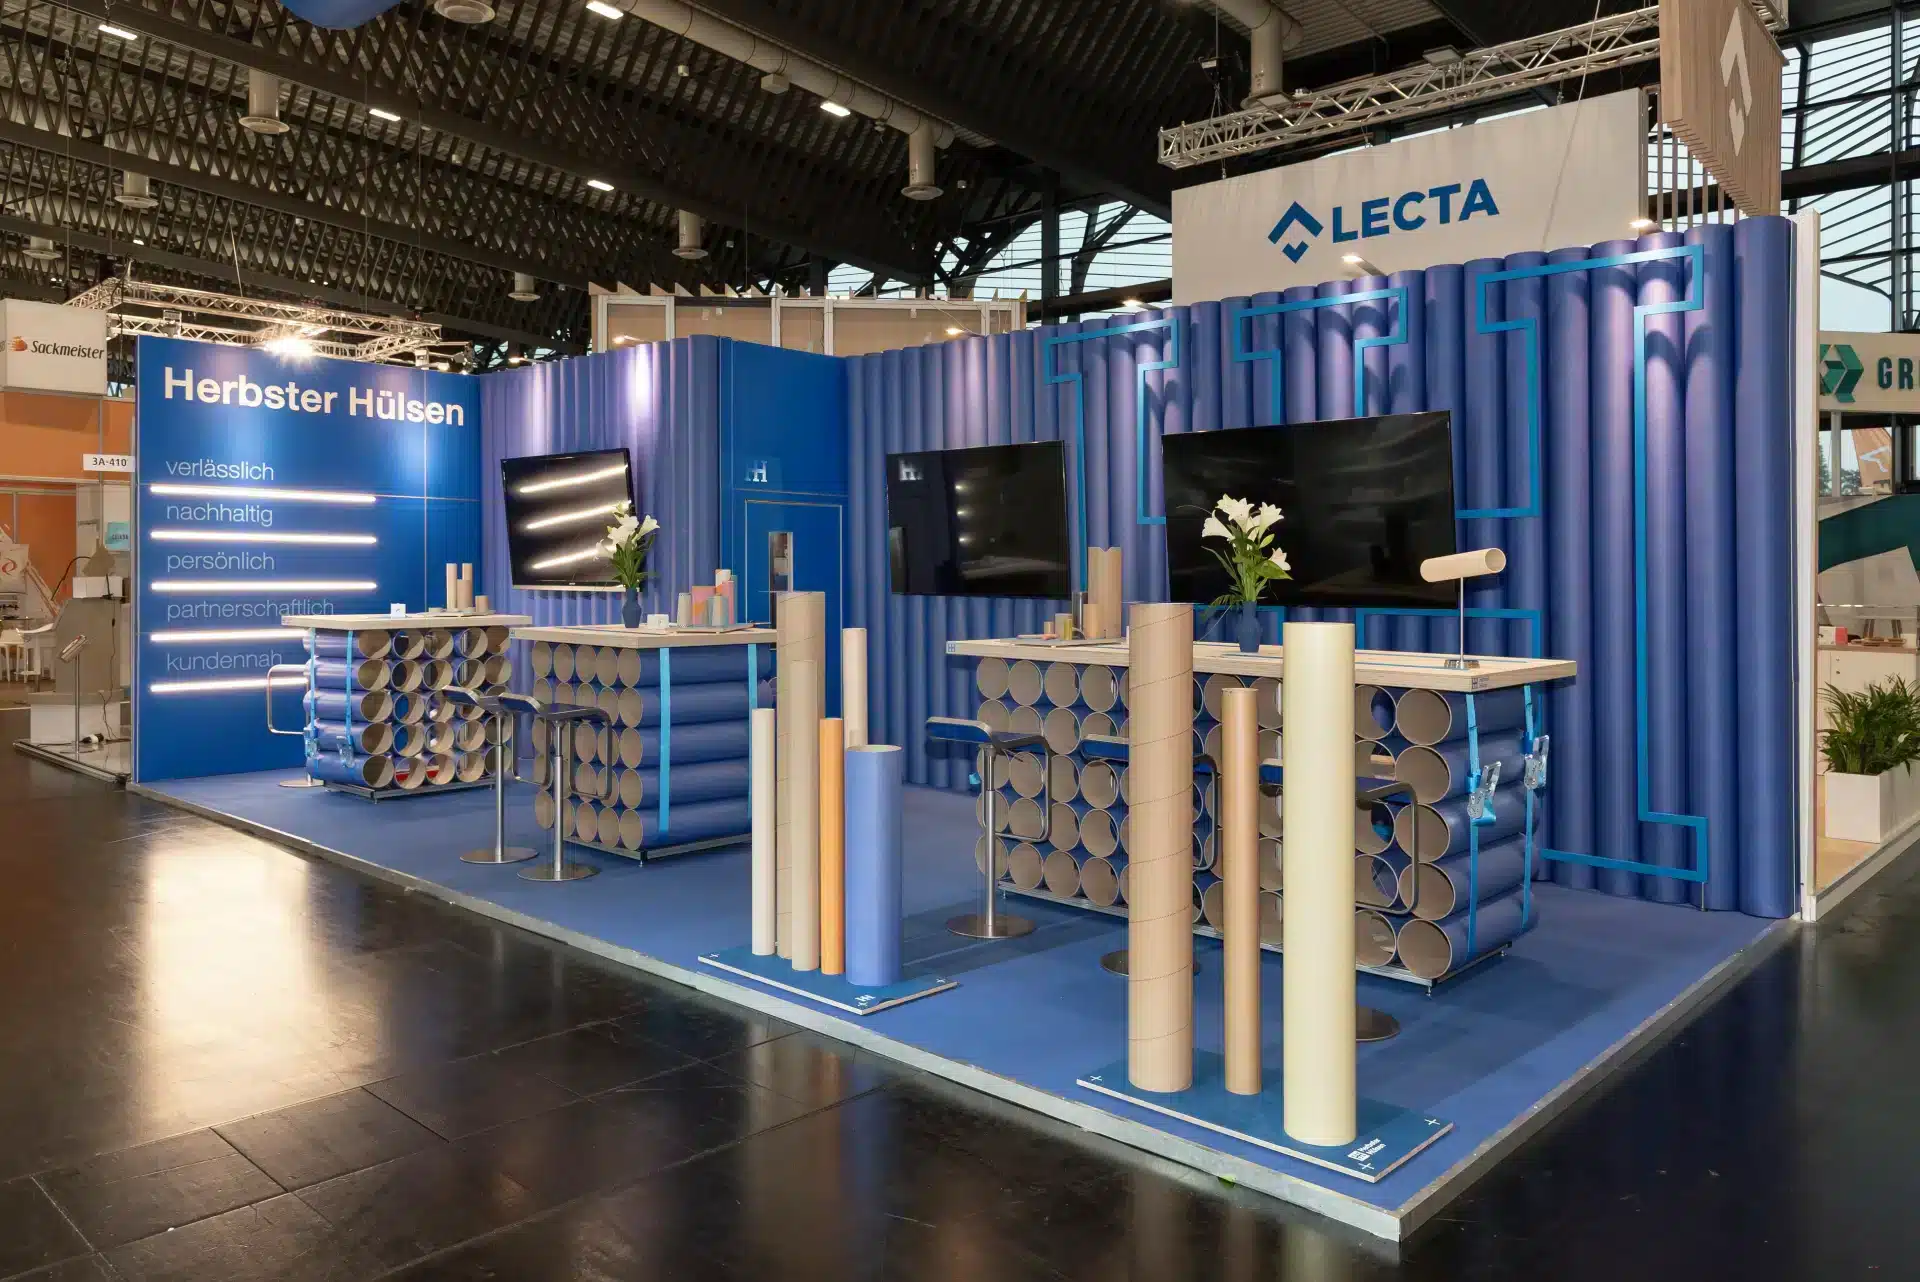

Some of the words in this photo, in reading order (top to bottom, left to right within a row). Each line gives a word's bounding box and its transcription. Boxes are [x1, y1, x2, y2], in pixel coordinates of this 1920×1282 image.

[1332, 178, 1500, 244] LECTA
[31, 340, 105, 359] Sackmeister
[1877, 356, 1920, 390] GR
[164, 366, 338, 413] Herbster
[349, 387, 464, 426] Hülsen
[92, 457, 127, 467] 3A-410
[166, 459, 275, 480] verlässlich
[166, 502, 273, 527] nachhaltig
[167, 552, 275, 572] persönlich
[167, 599, 334, 622] partnerschaftlich
[167, 650, 283, 671] kundennah
